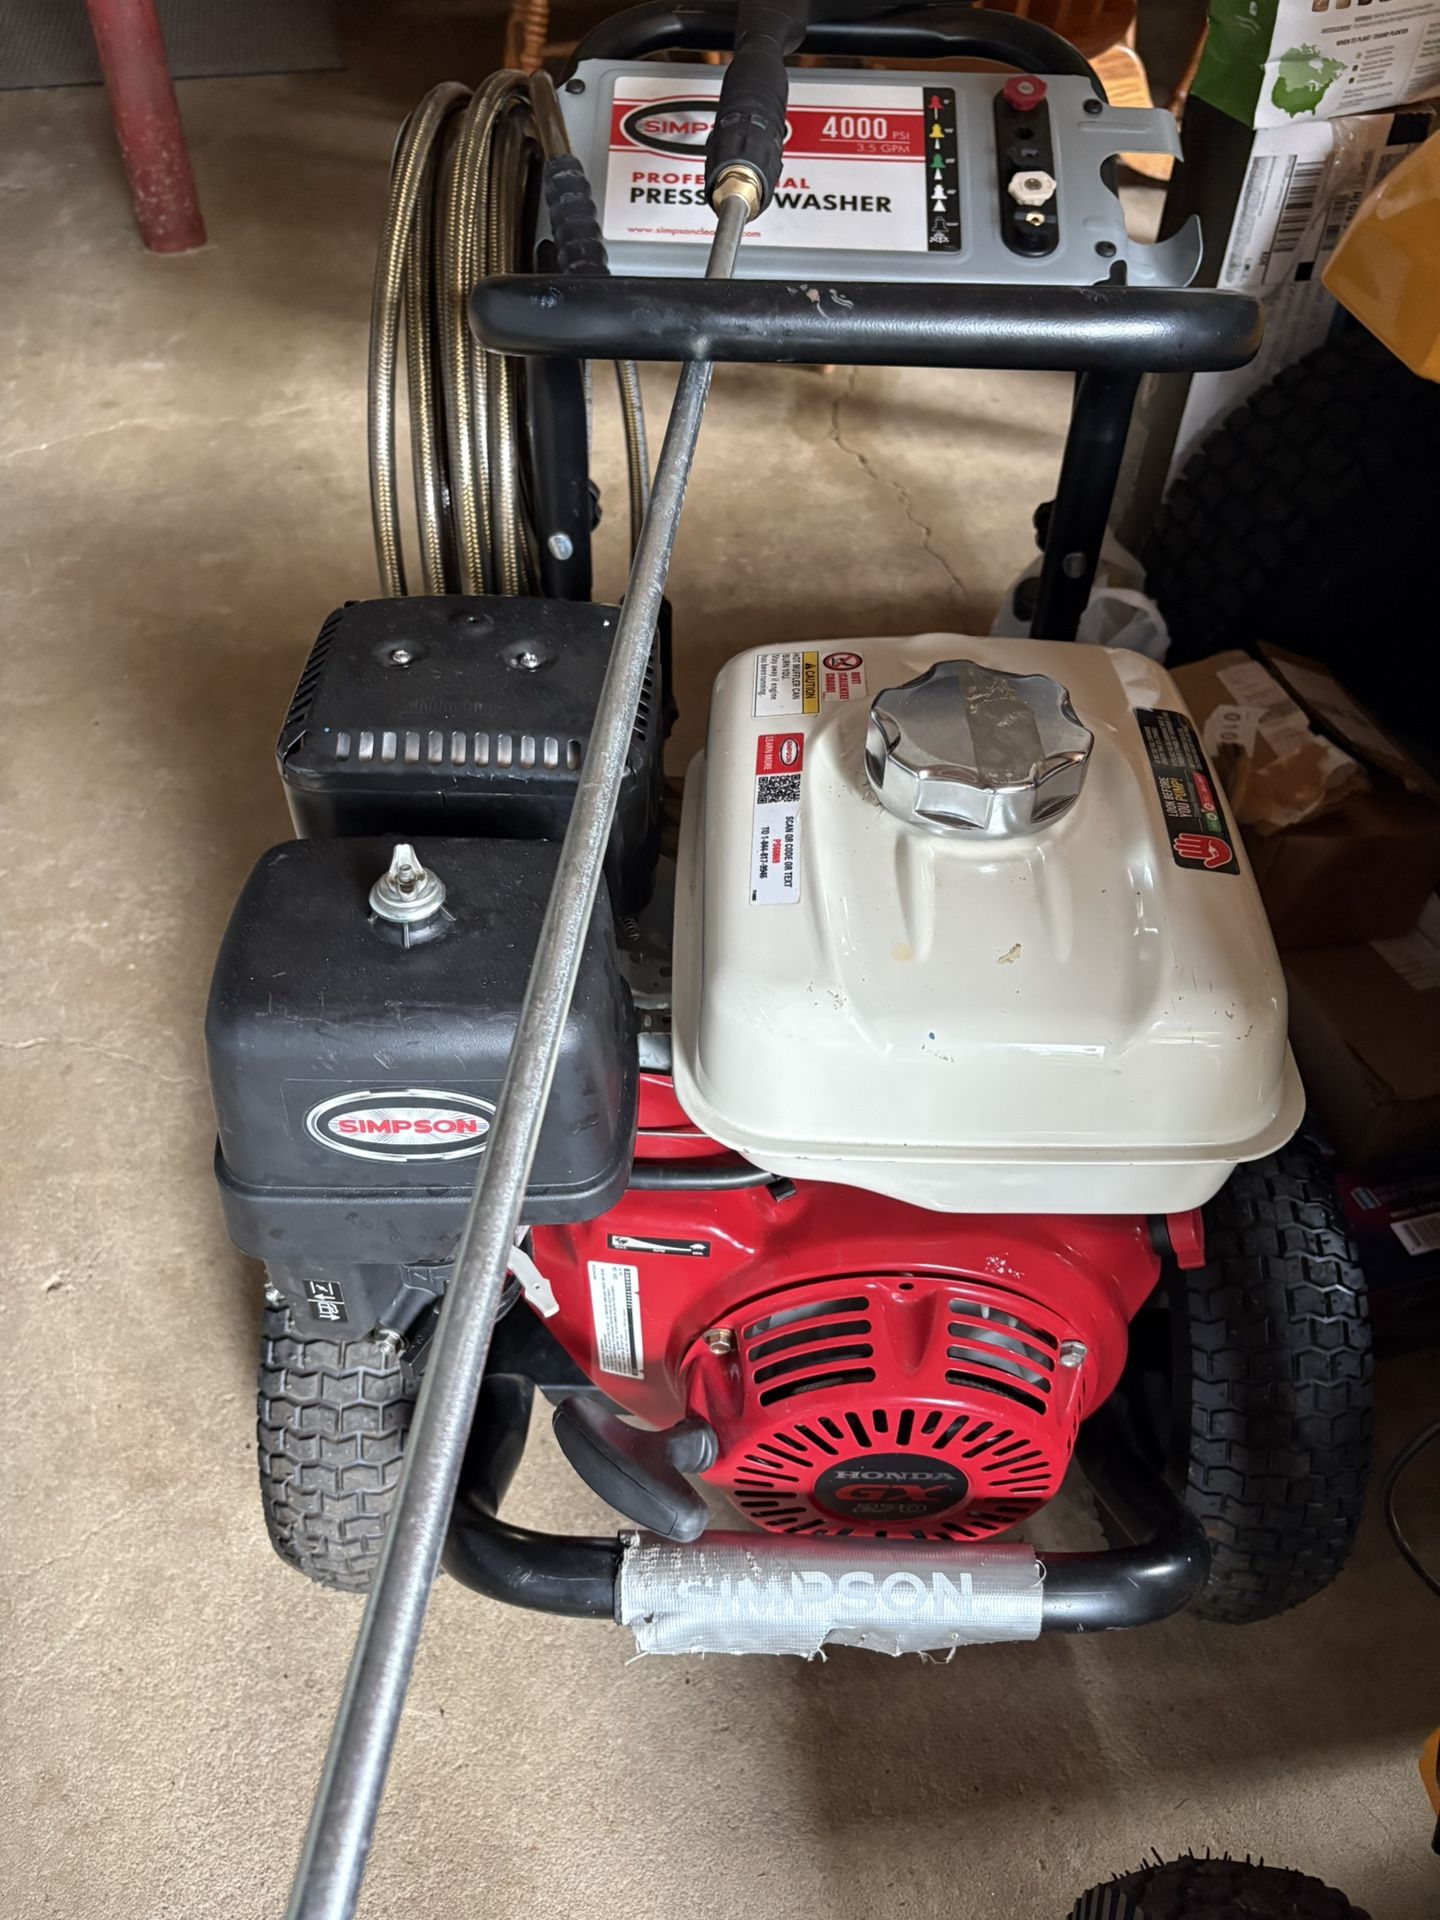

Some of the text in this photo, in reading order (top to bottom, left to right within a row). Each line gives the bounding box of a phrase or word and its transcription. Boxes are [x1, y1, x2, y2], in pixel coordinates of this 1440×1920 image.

[644, 120, 715, 135] SIMP
[822, 115, 910, 141] 4000 PSI
[857, 142, 911, 154] 3.5 GPM
[774, 192, 892, 214] WASHER
[770, 654, 780, 665] Stay
[781, 654, 791, 668] BURN
[768, 664, 778, 677] away
[791, 653, 801, 700] HOT MUFFLER CAN
[768, 682, 779, 700] engine
[804, 669, 816, 699] CAUTION
[763, 736, 775, 771] LEARN MORE
[1158, 776, 1179, 817] LOOK BEFORE
[1170, 777, 1192, 818] YOU PUMP!
[760, 826, 770, 835] TO
[783, 815, 794, 888] SCAN QR CODE OR TEXT
[339, 1119, 477, 1134] SIMPSON
[835, 1470, 957, 1482] HONDA
[835, 1483, 950, 1503] GX
